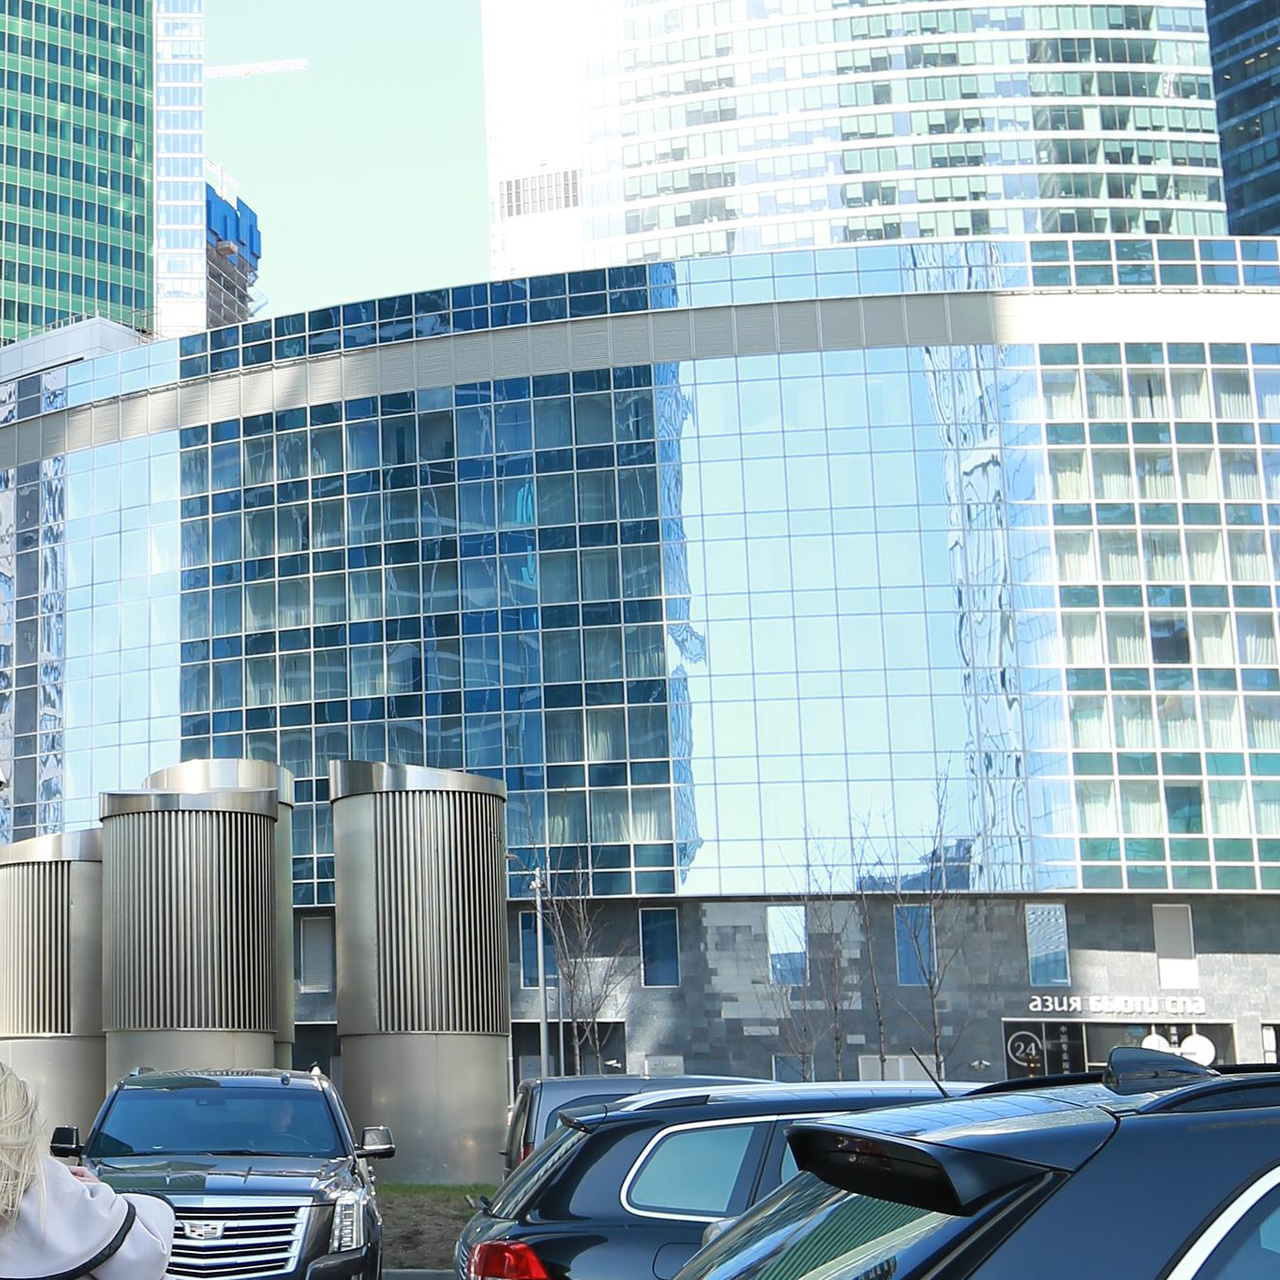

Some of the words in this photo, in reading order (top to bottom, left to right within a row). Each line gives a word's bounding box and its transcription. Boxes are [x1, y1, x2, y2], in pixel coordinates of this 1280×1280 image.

[1028, 995, 1082, 1013] азия
[1165, 996, 1206, 1015] спа
[1014, 1041, 1037, 1057] 24
